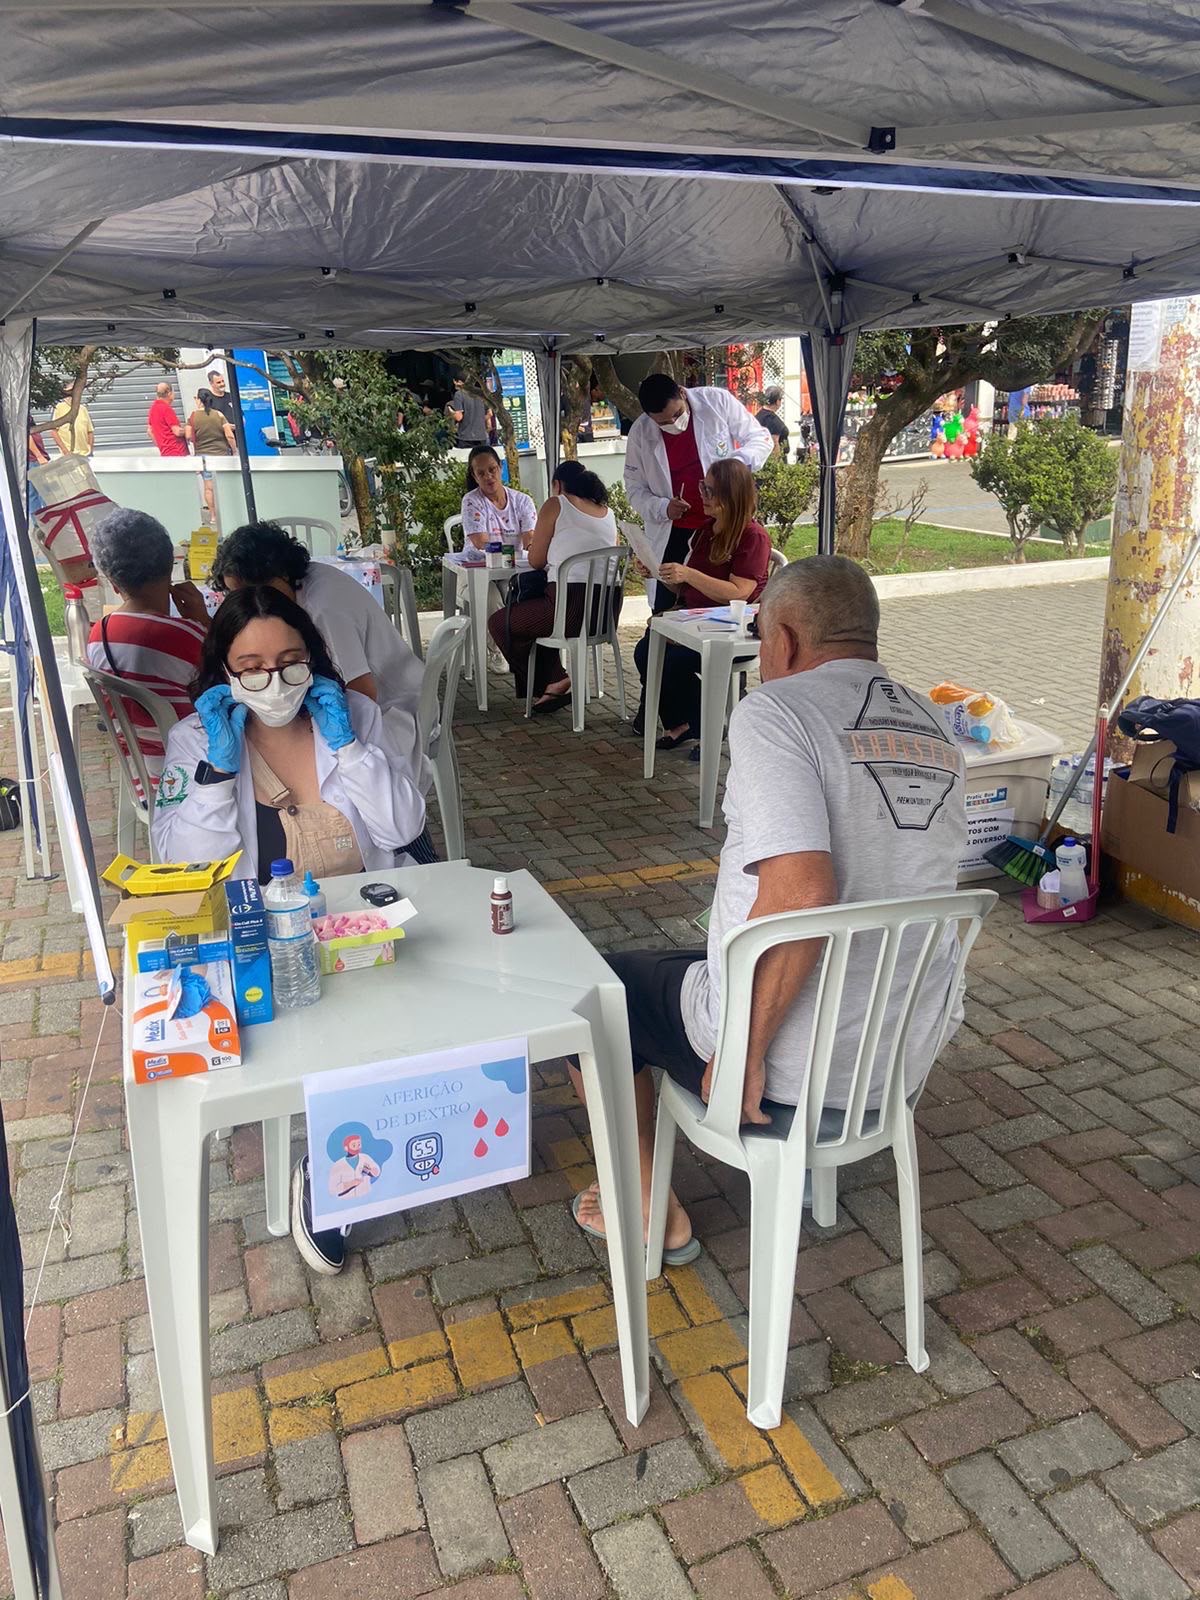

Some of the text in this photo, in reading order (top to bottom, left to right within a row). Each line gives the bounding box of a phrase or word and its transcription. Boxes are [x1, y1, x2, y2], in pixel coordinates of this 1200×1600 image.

[983, 825, 1000, 833] COM
[972, 834, 1007, 845] DIVERSOS
[381, 1081, 463, 1107] AFERIÇÃO
[375, 1101, 471, 1132] DE DEXTRO
